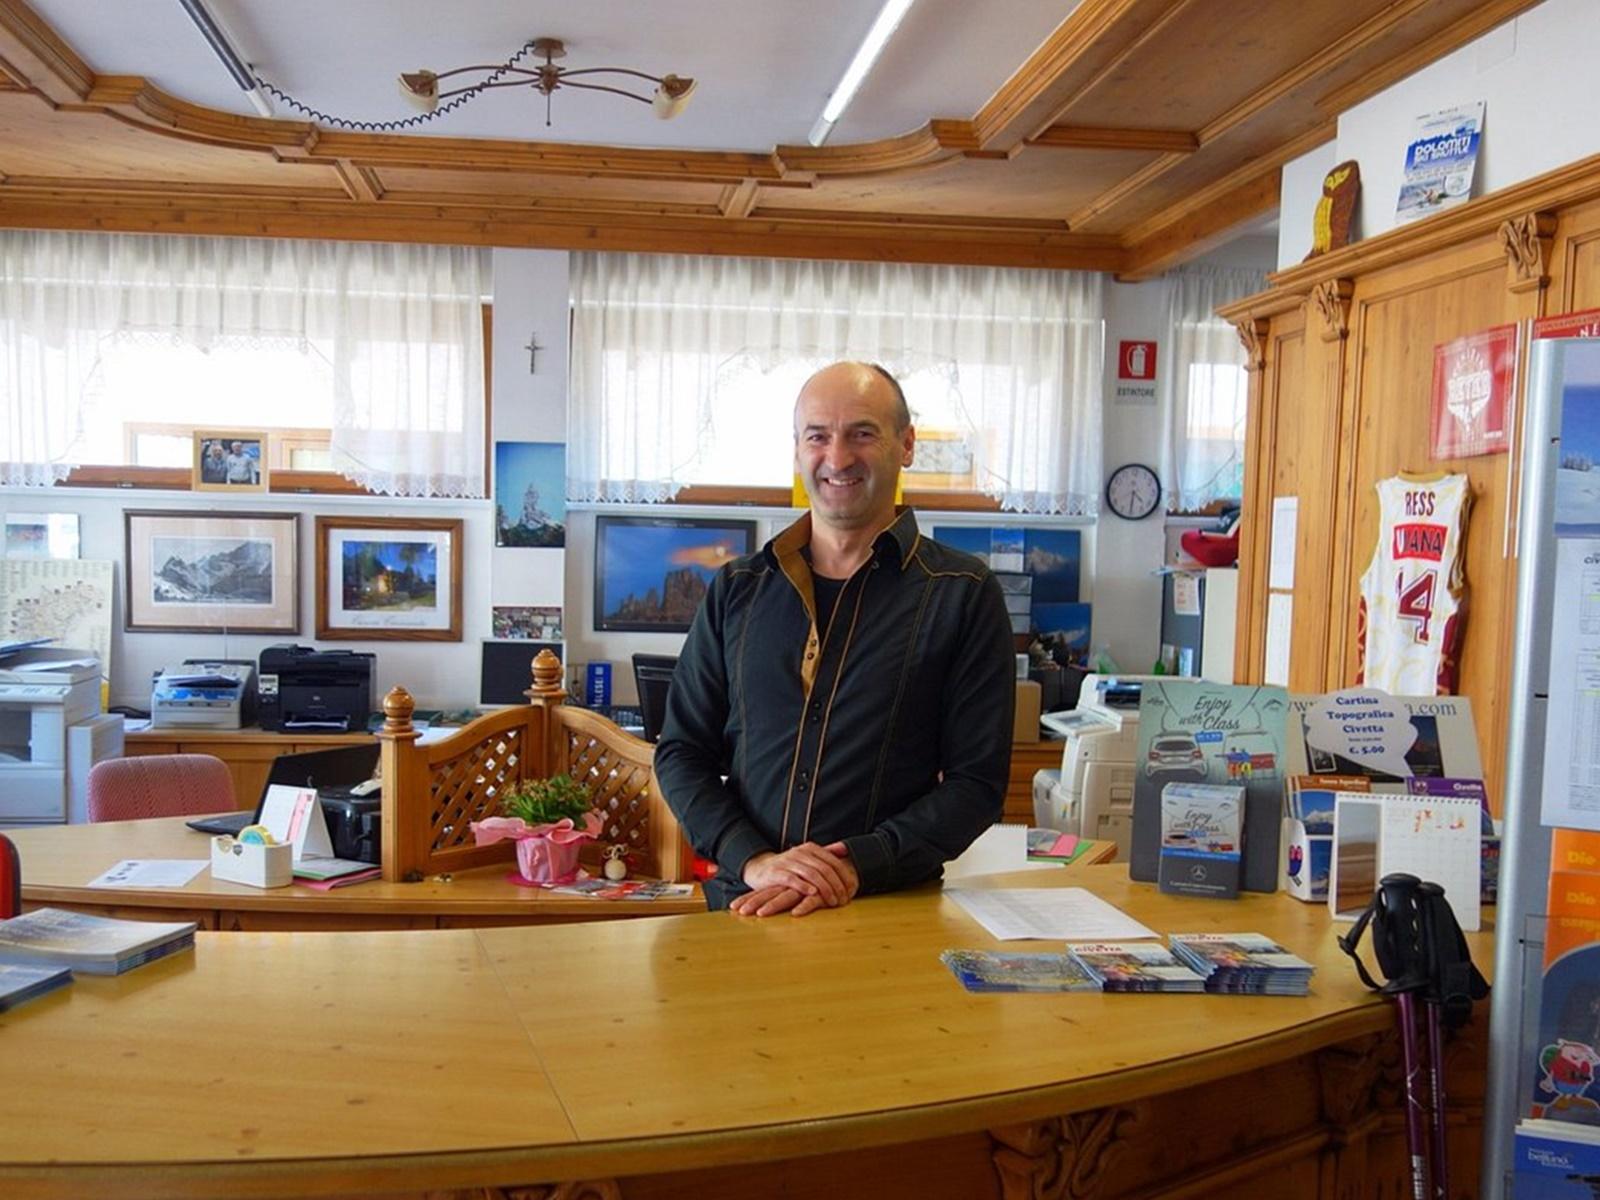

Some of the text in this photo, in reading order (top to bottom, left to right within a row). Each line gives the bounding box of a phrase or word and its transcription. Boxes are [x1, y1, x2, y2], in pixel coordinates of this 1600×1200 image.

[1405, 491, 1436, 516] RESS
[1396, 527, 1443, 554] UANA
[1194, 695, 1232, 716] Enjoy
[1336, 696, 1379, 706] Cartina
[1326, 711, 1395, 721] Topografica
[1404, 703, 1457, 716] a.com
[1203, 717, 1241, 731] Class
[1343, 725, 1384, 734] Civetta
[1362, 745, 1385, 755] 5.00
